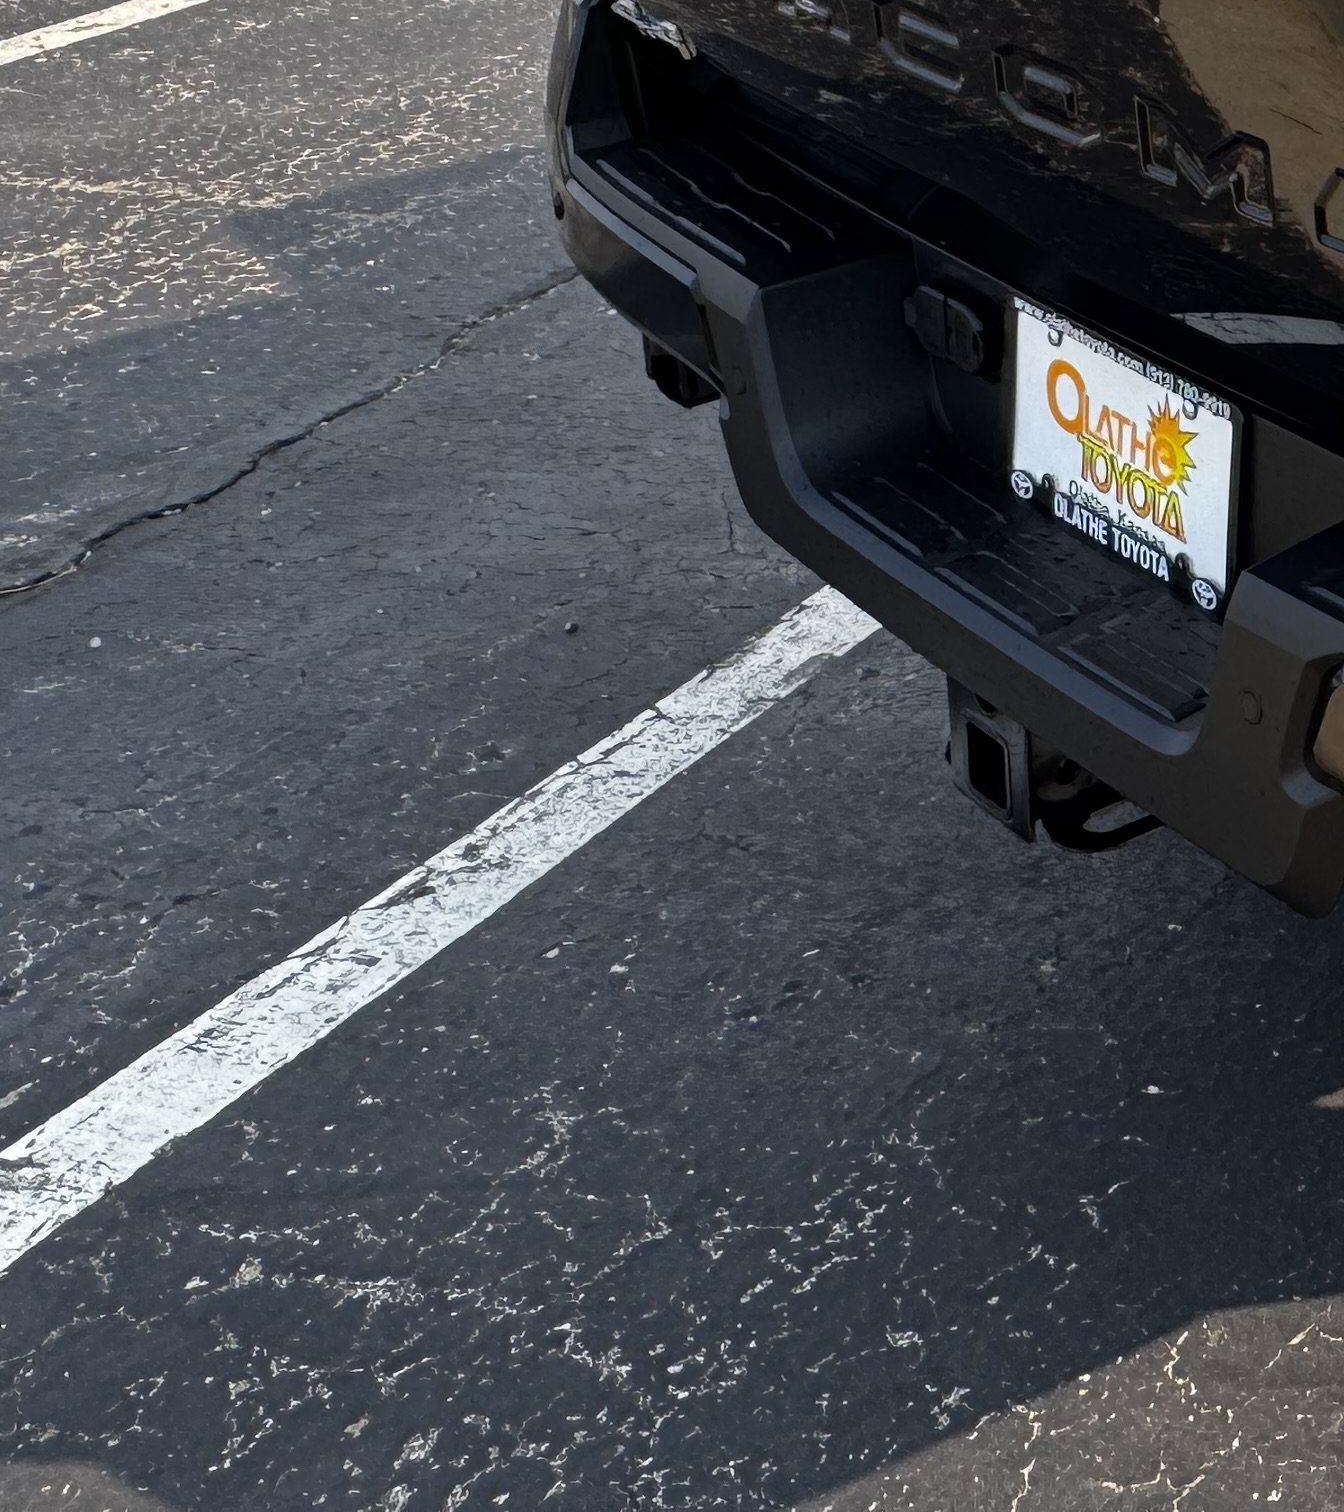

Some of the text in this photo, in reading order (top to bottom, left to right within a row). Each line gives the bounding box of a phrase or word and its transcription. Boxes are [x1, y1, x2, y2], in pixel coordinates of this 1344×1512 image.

[1053, 492, 1170, 582] OLATHE TOYOTA
[1078, 433, 1187, 544] TOYOTA
